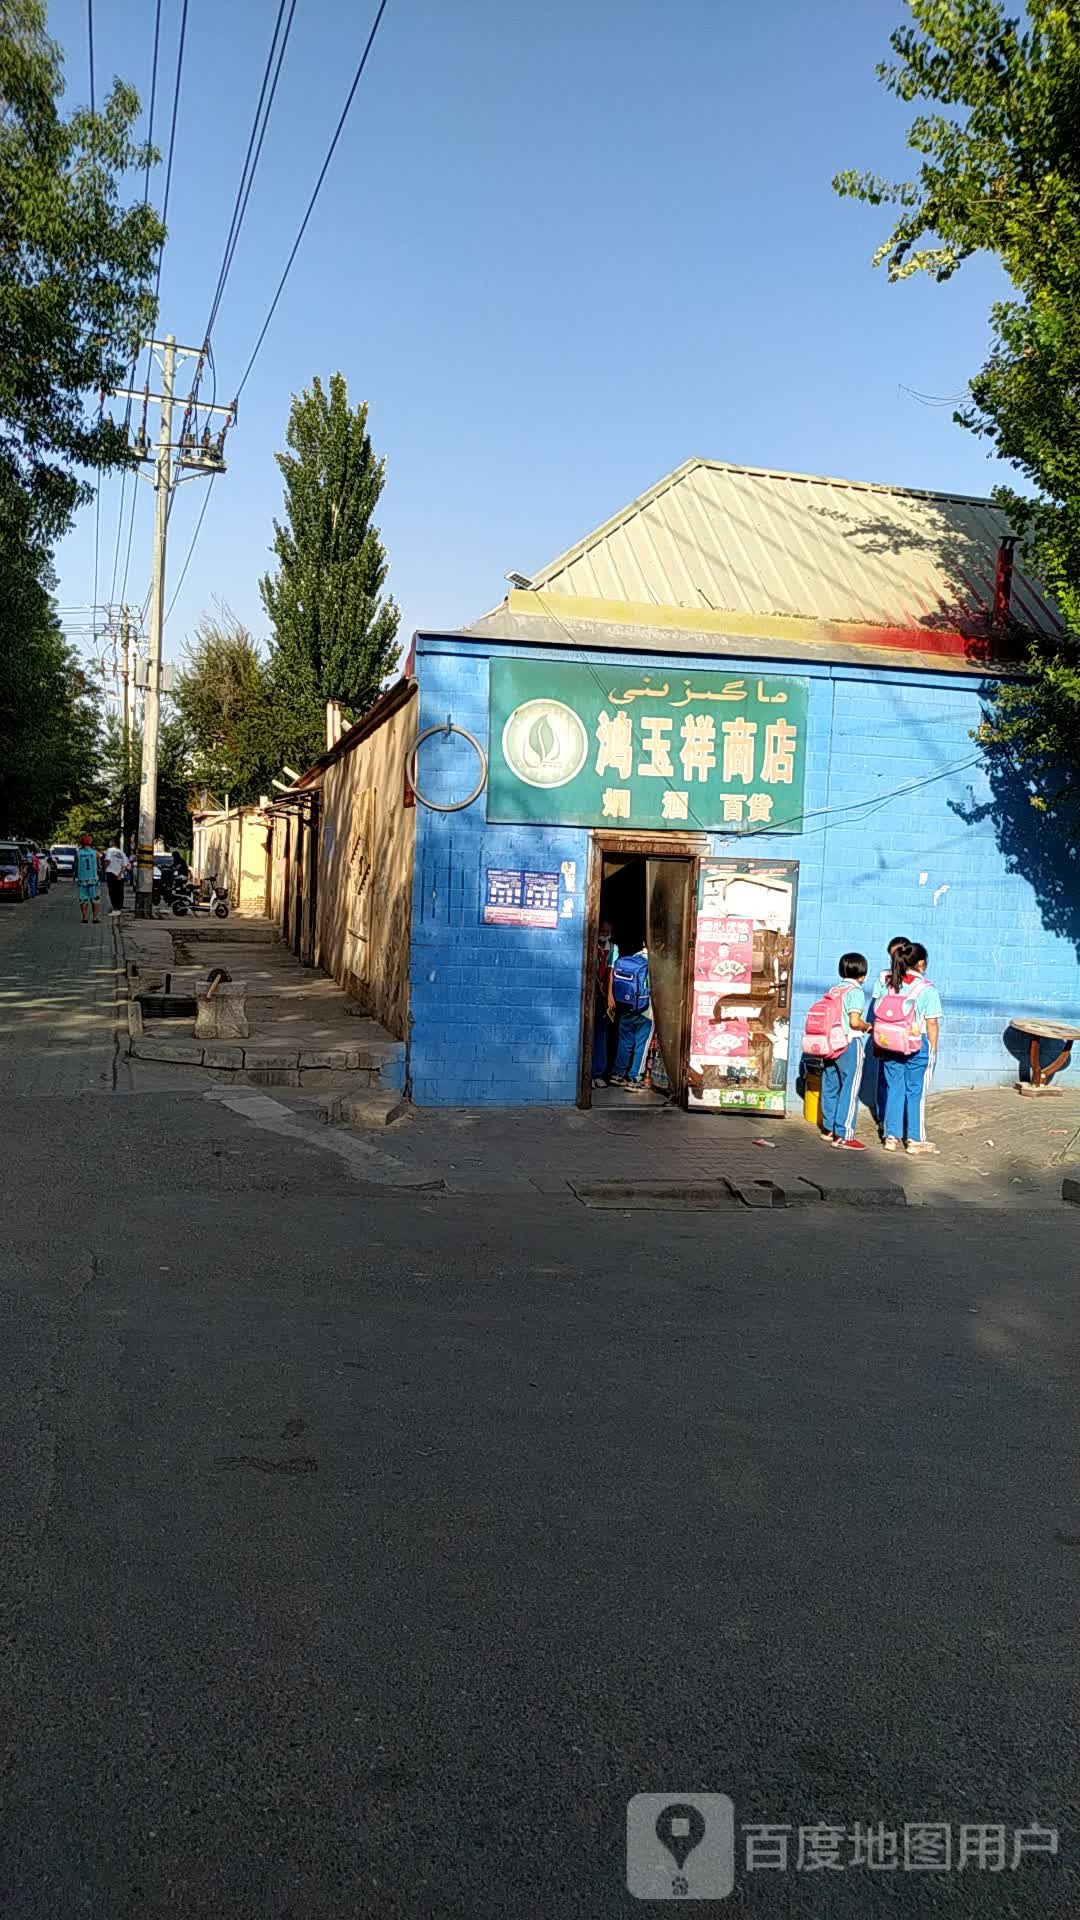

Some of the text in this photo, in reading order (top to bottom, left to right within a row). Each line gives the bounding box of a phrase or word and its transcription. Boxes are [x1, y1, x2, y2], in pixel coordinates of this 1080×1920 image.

[595, 710, 797, 784] 鸿玉祥商店
[602, 788, 773, 822] 烟 酒 百货
